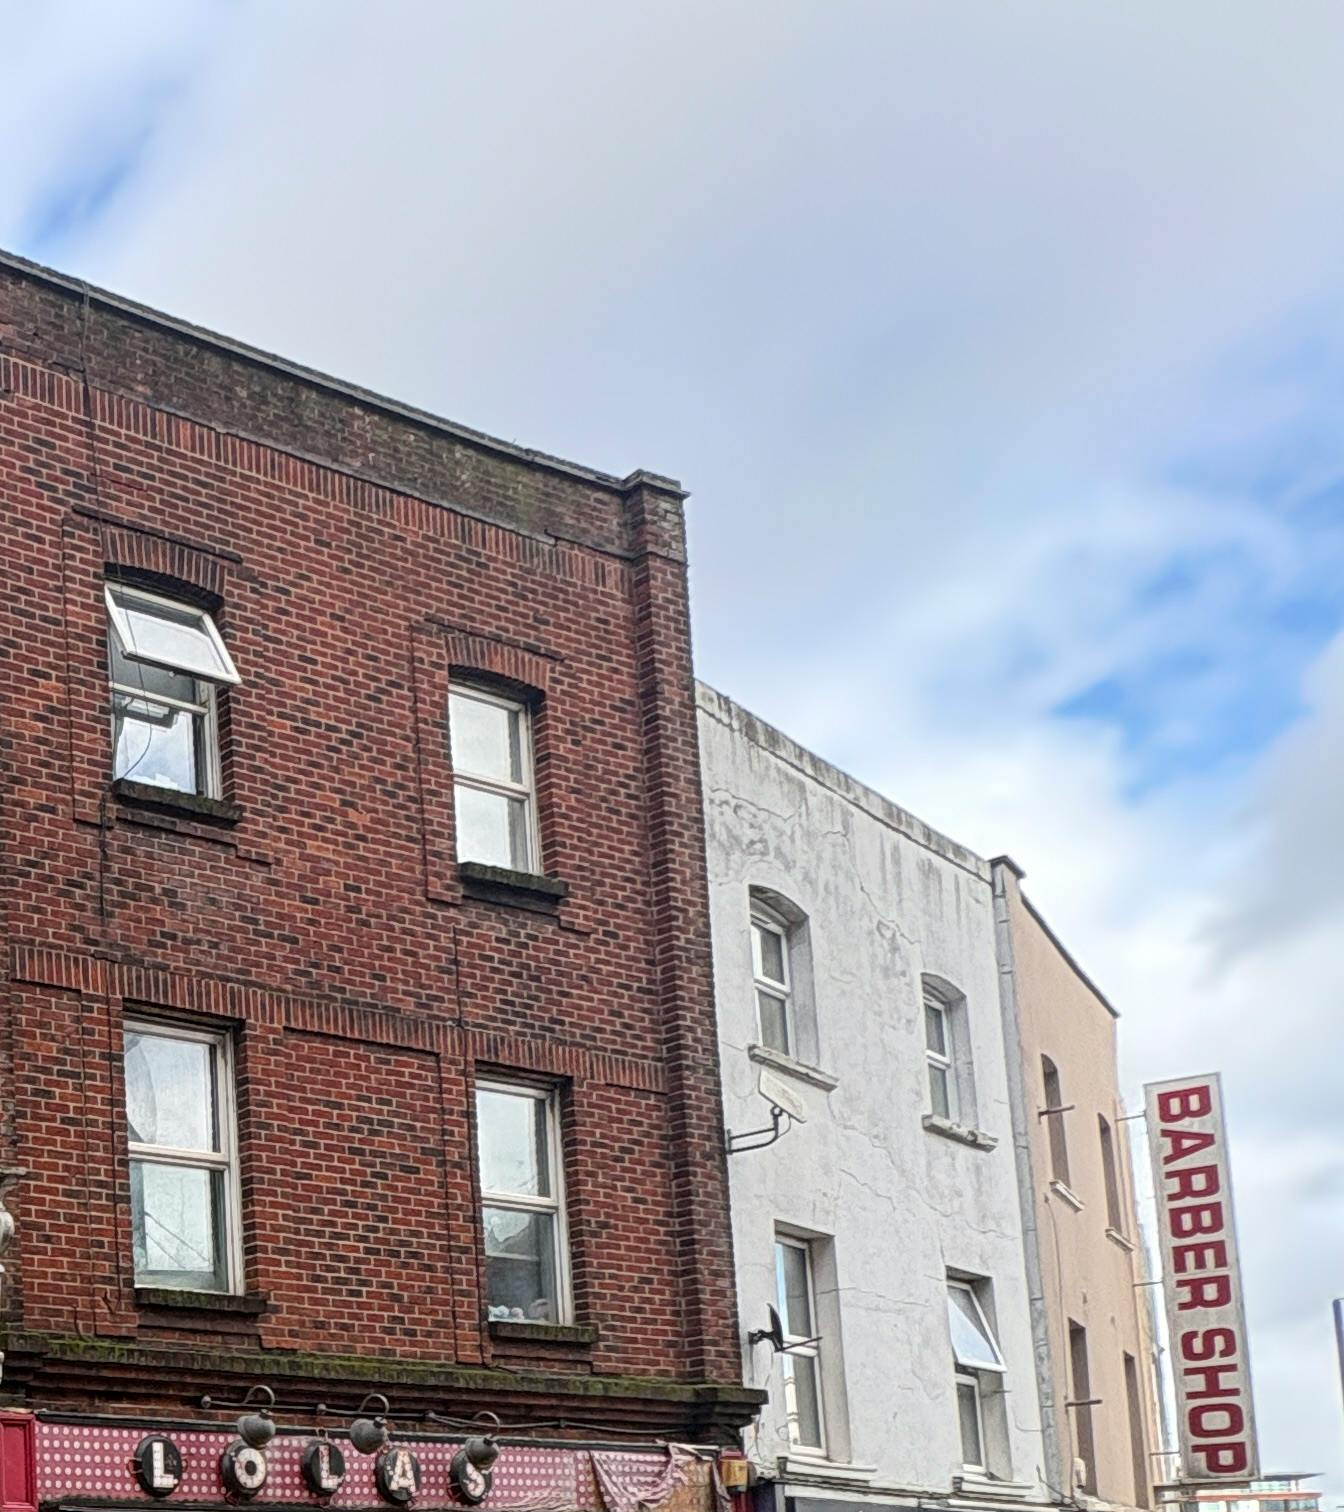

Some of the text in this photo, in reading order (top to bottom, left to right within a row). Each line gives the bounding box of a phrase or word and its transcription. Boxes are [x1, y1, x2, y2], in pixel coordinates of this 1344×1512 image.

[1158, 1084, 1249, 1475] BARBER SHOP
[152, 1440, 488, 1499] LOLAS
